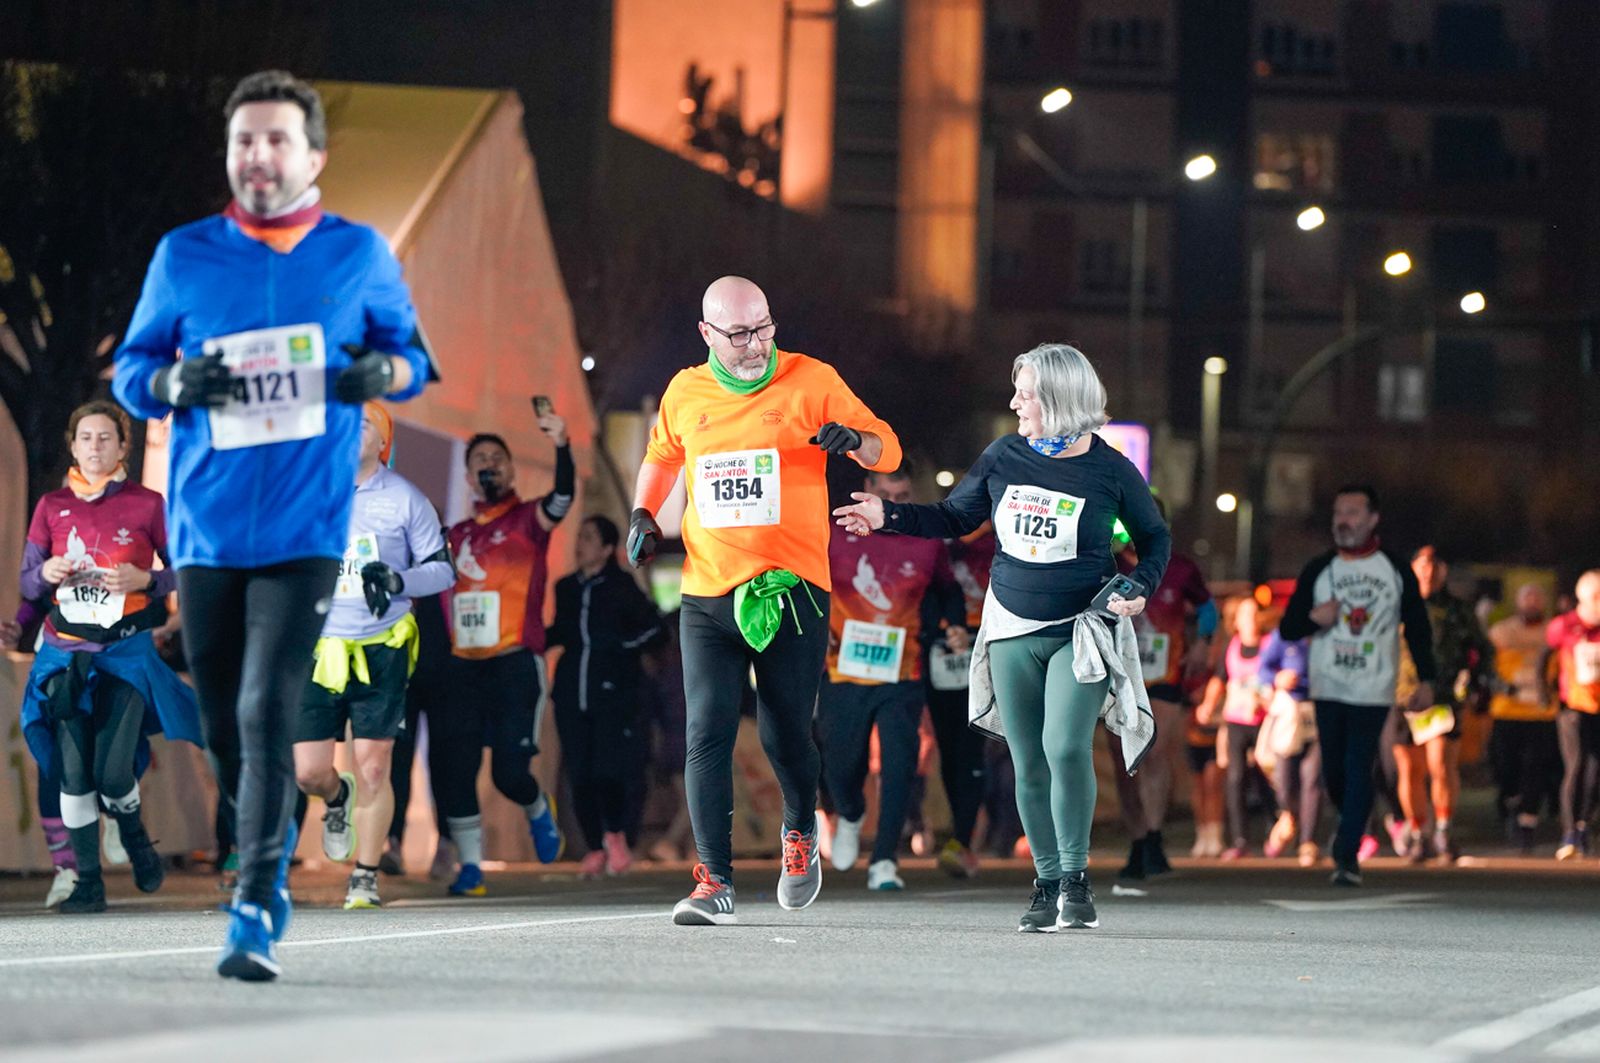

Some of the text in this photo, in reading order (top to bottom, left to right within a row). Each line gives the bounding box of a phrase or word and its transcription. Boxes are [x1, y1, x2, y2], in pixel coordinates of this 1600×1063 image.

[703, 471, 720, 480] SAN
[713, 460, 737, 470] NOCHE
[711, 477, 764, 501] 1354
[1013, 512, 1058, 539] 1125
[72, 585, 111, 606] 1862
